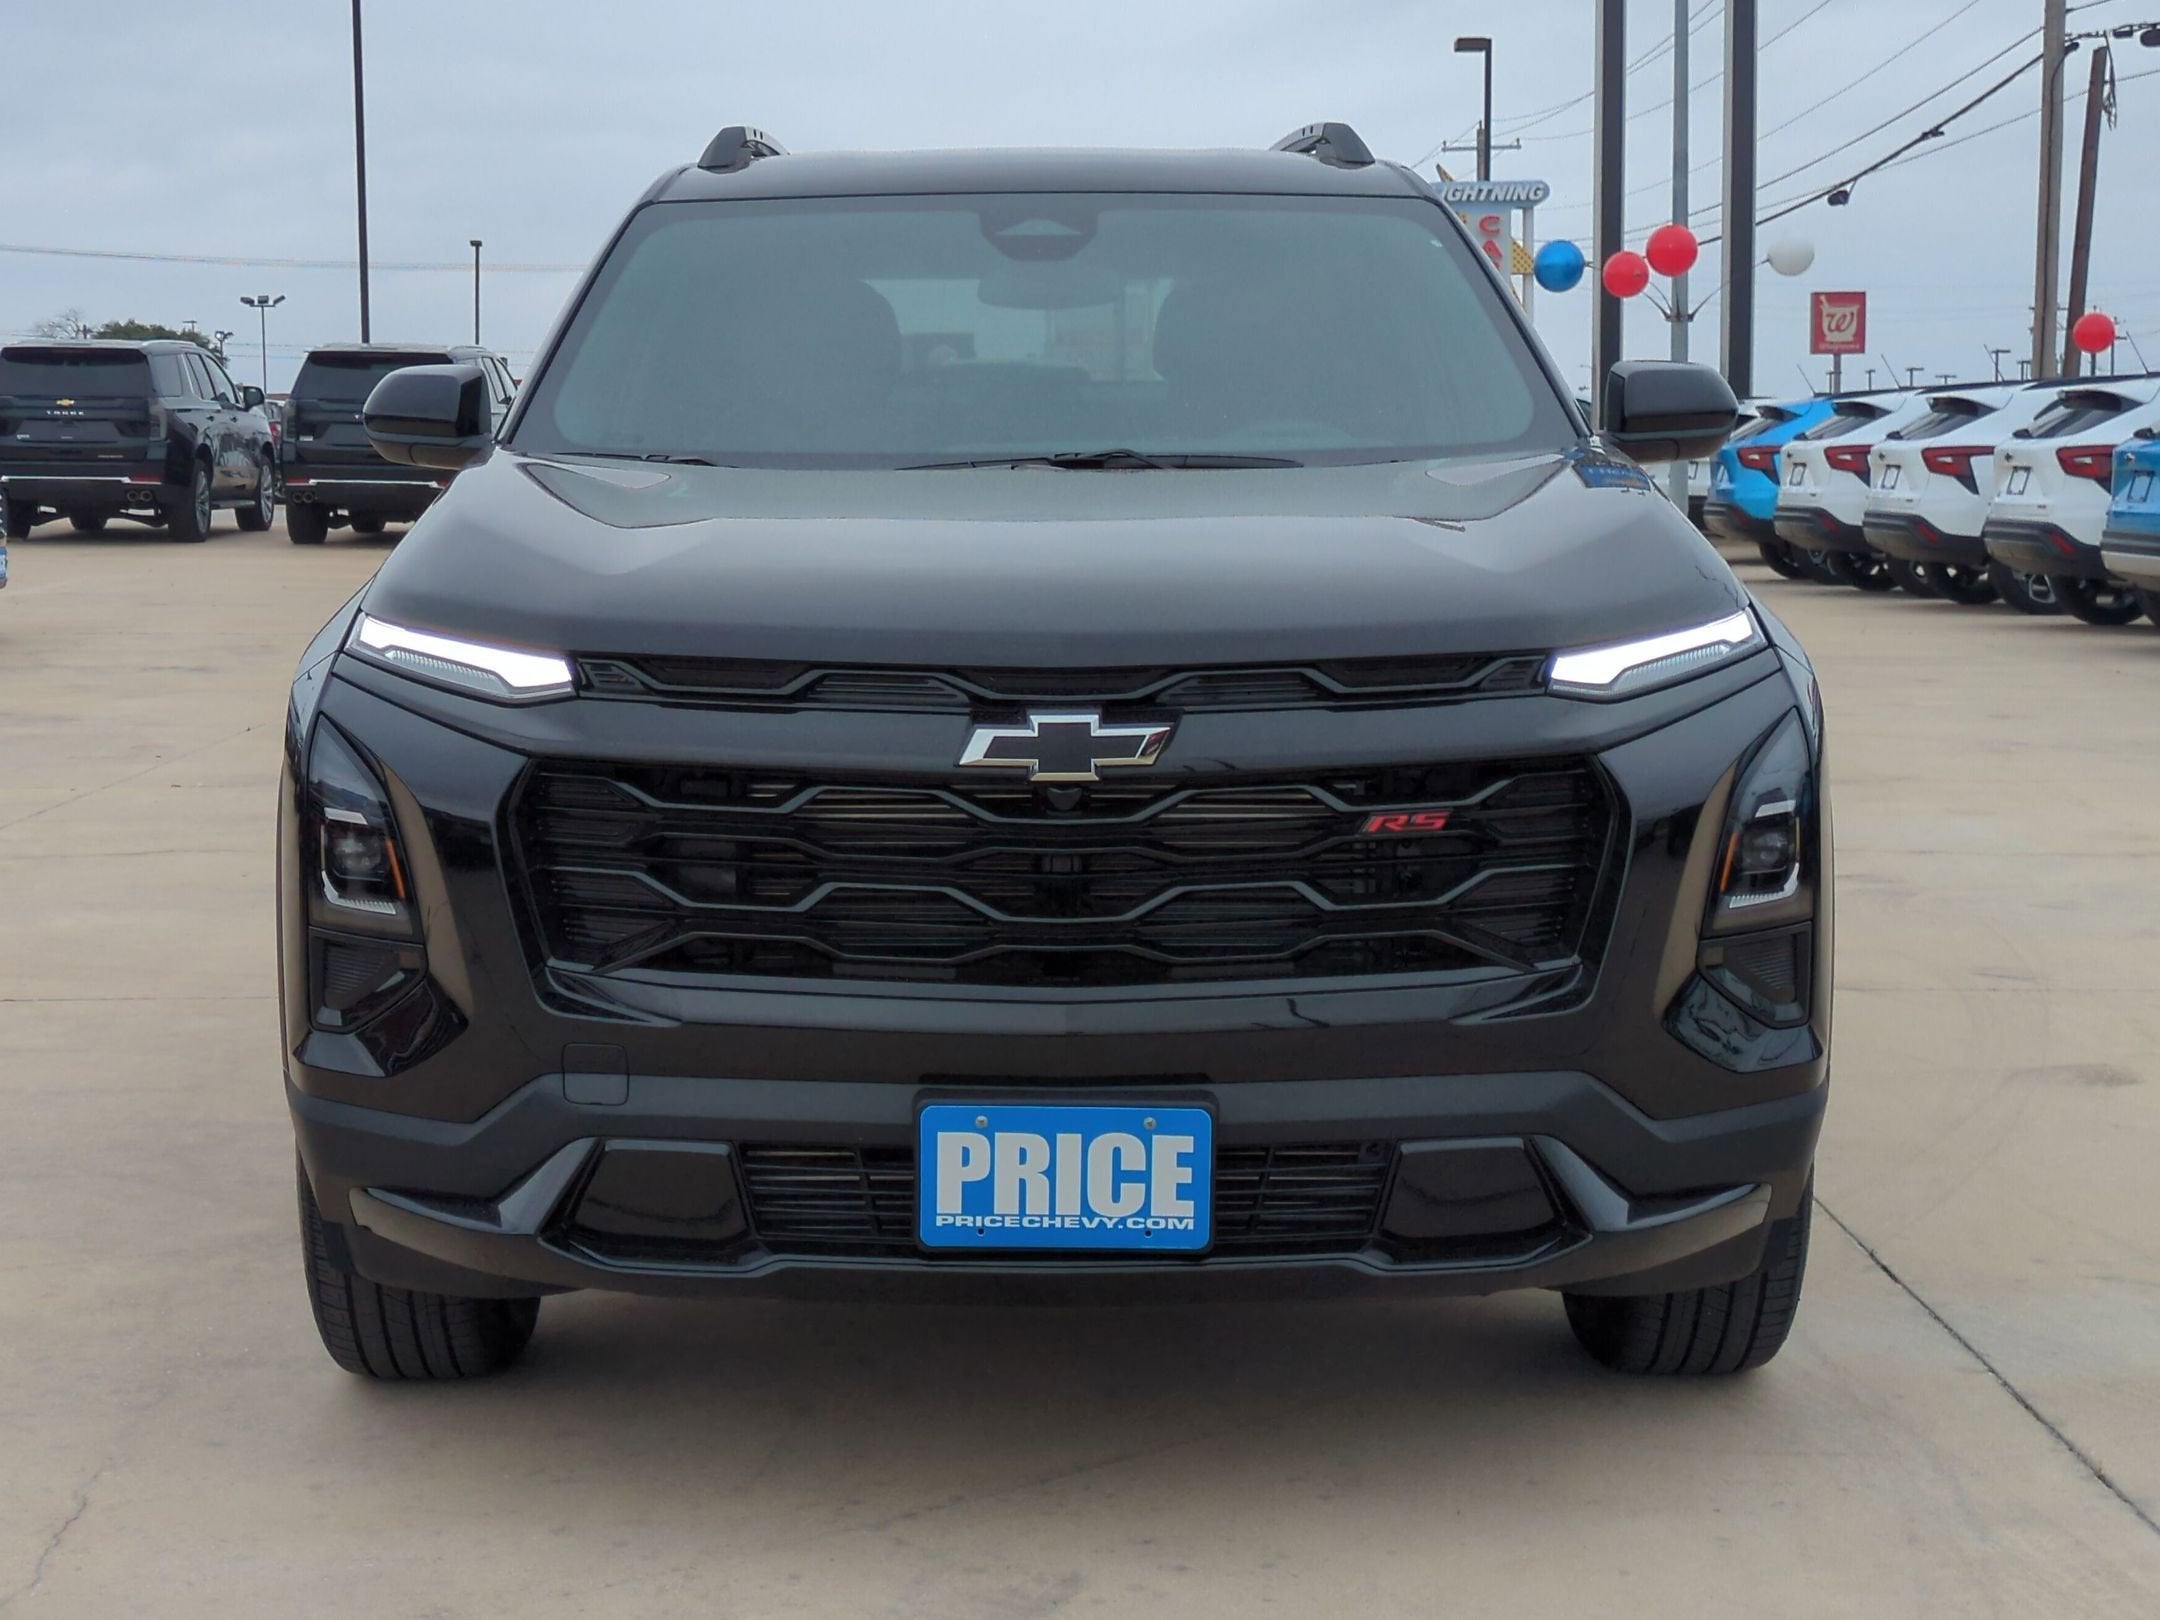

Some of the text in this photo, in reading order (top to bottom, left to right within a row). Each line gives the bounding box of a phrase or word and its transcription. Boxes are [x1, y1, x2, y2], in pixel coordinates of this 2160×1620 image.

[1441, 184, 1545, 202] IGHTNING
[1366, 811, 1451, 833] RS
[936, 1131, 1195, 1217] PRICE
[935, 1215, 1195, 1231] PRICECHEVY.COM
